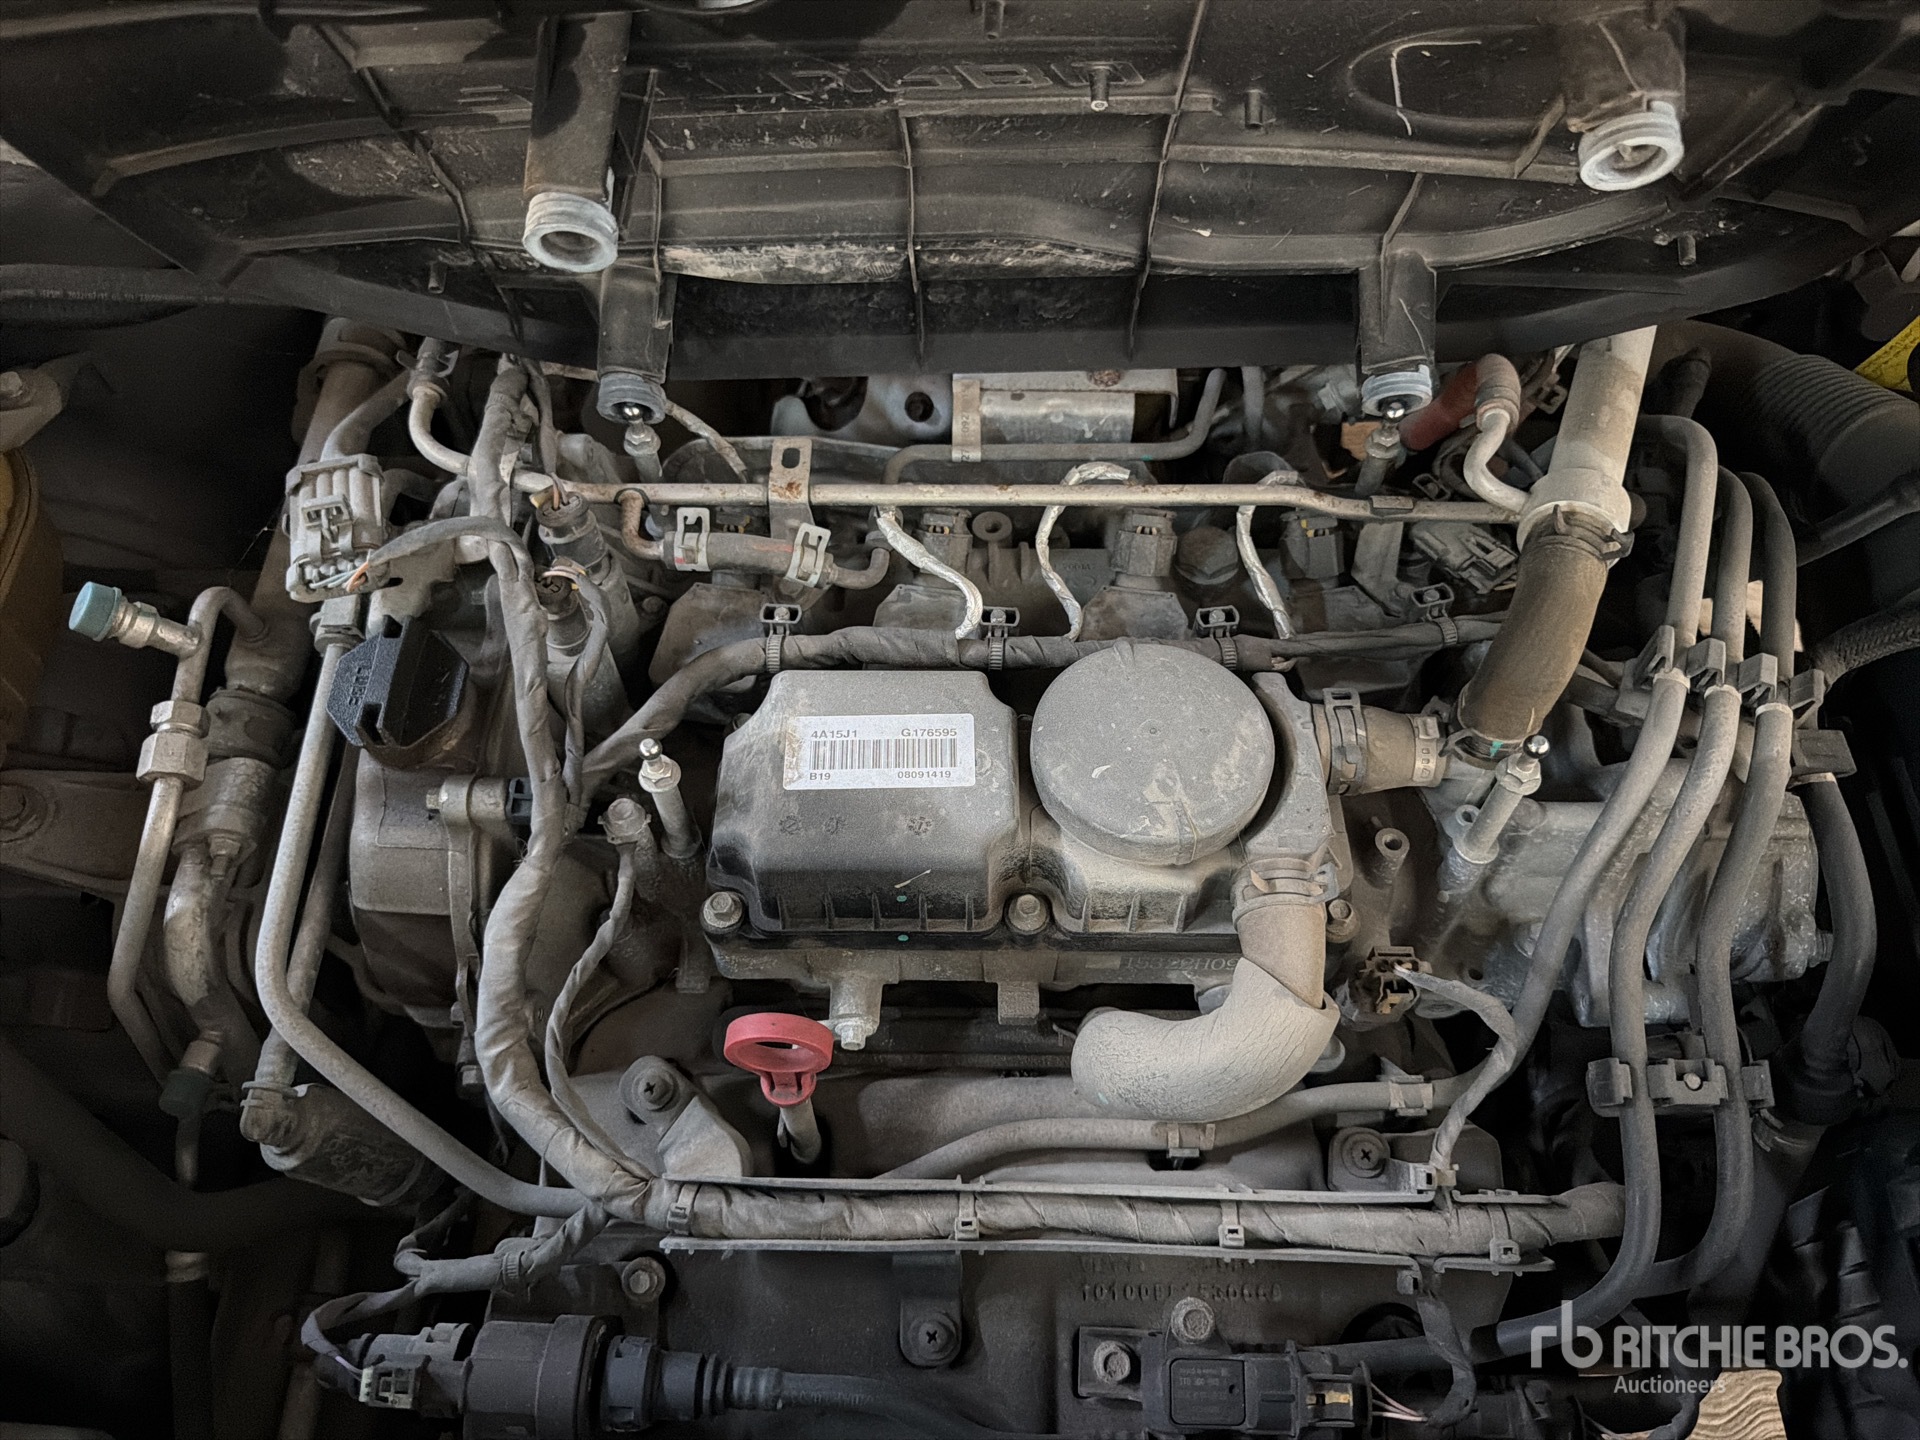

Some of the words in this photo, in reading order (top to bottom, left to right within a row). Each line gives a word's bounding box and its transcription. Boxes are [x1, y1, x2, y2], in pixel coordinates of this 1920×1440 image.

[811, 729, 858, 739] 4A15J1
[901, 728, 957, 737] G176595
[809, 771, 831, 781] B19
[897, 769, 952, 779] 08091419
